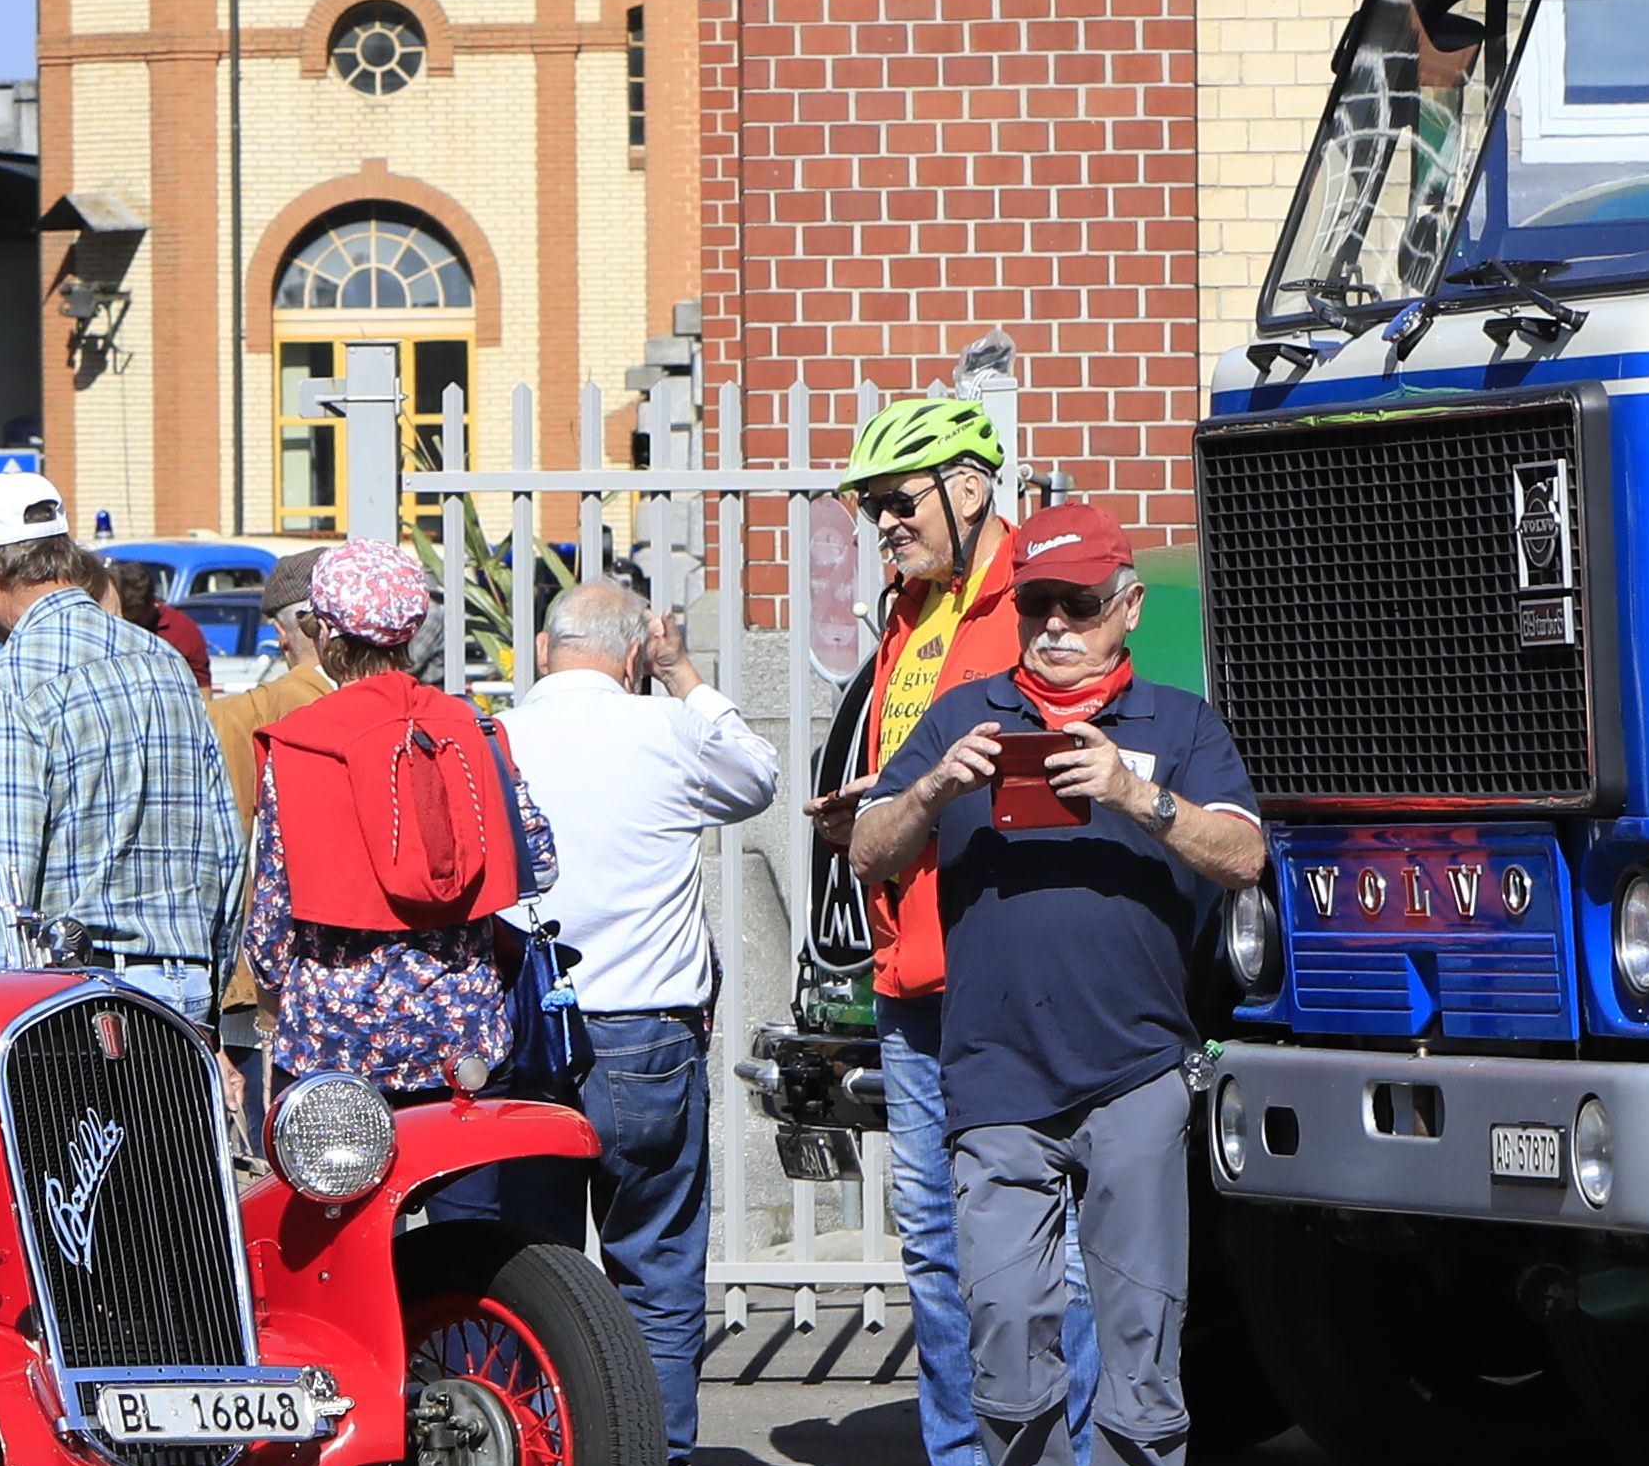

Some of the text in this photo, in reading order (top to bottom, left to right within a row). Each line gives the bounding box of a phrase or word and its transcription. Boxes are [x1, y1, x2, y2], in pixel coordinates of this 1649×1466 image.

[1522, 518, 1555, 534] VOLVO
[1304, 864, 1532, 917] VOLVO
[1517, 1134, 1556, 1172] 57879
[45, 1107, 124, 1274] Balilla
[116, 1391, 300, 1433] BL 16848
